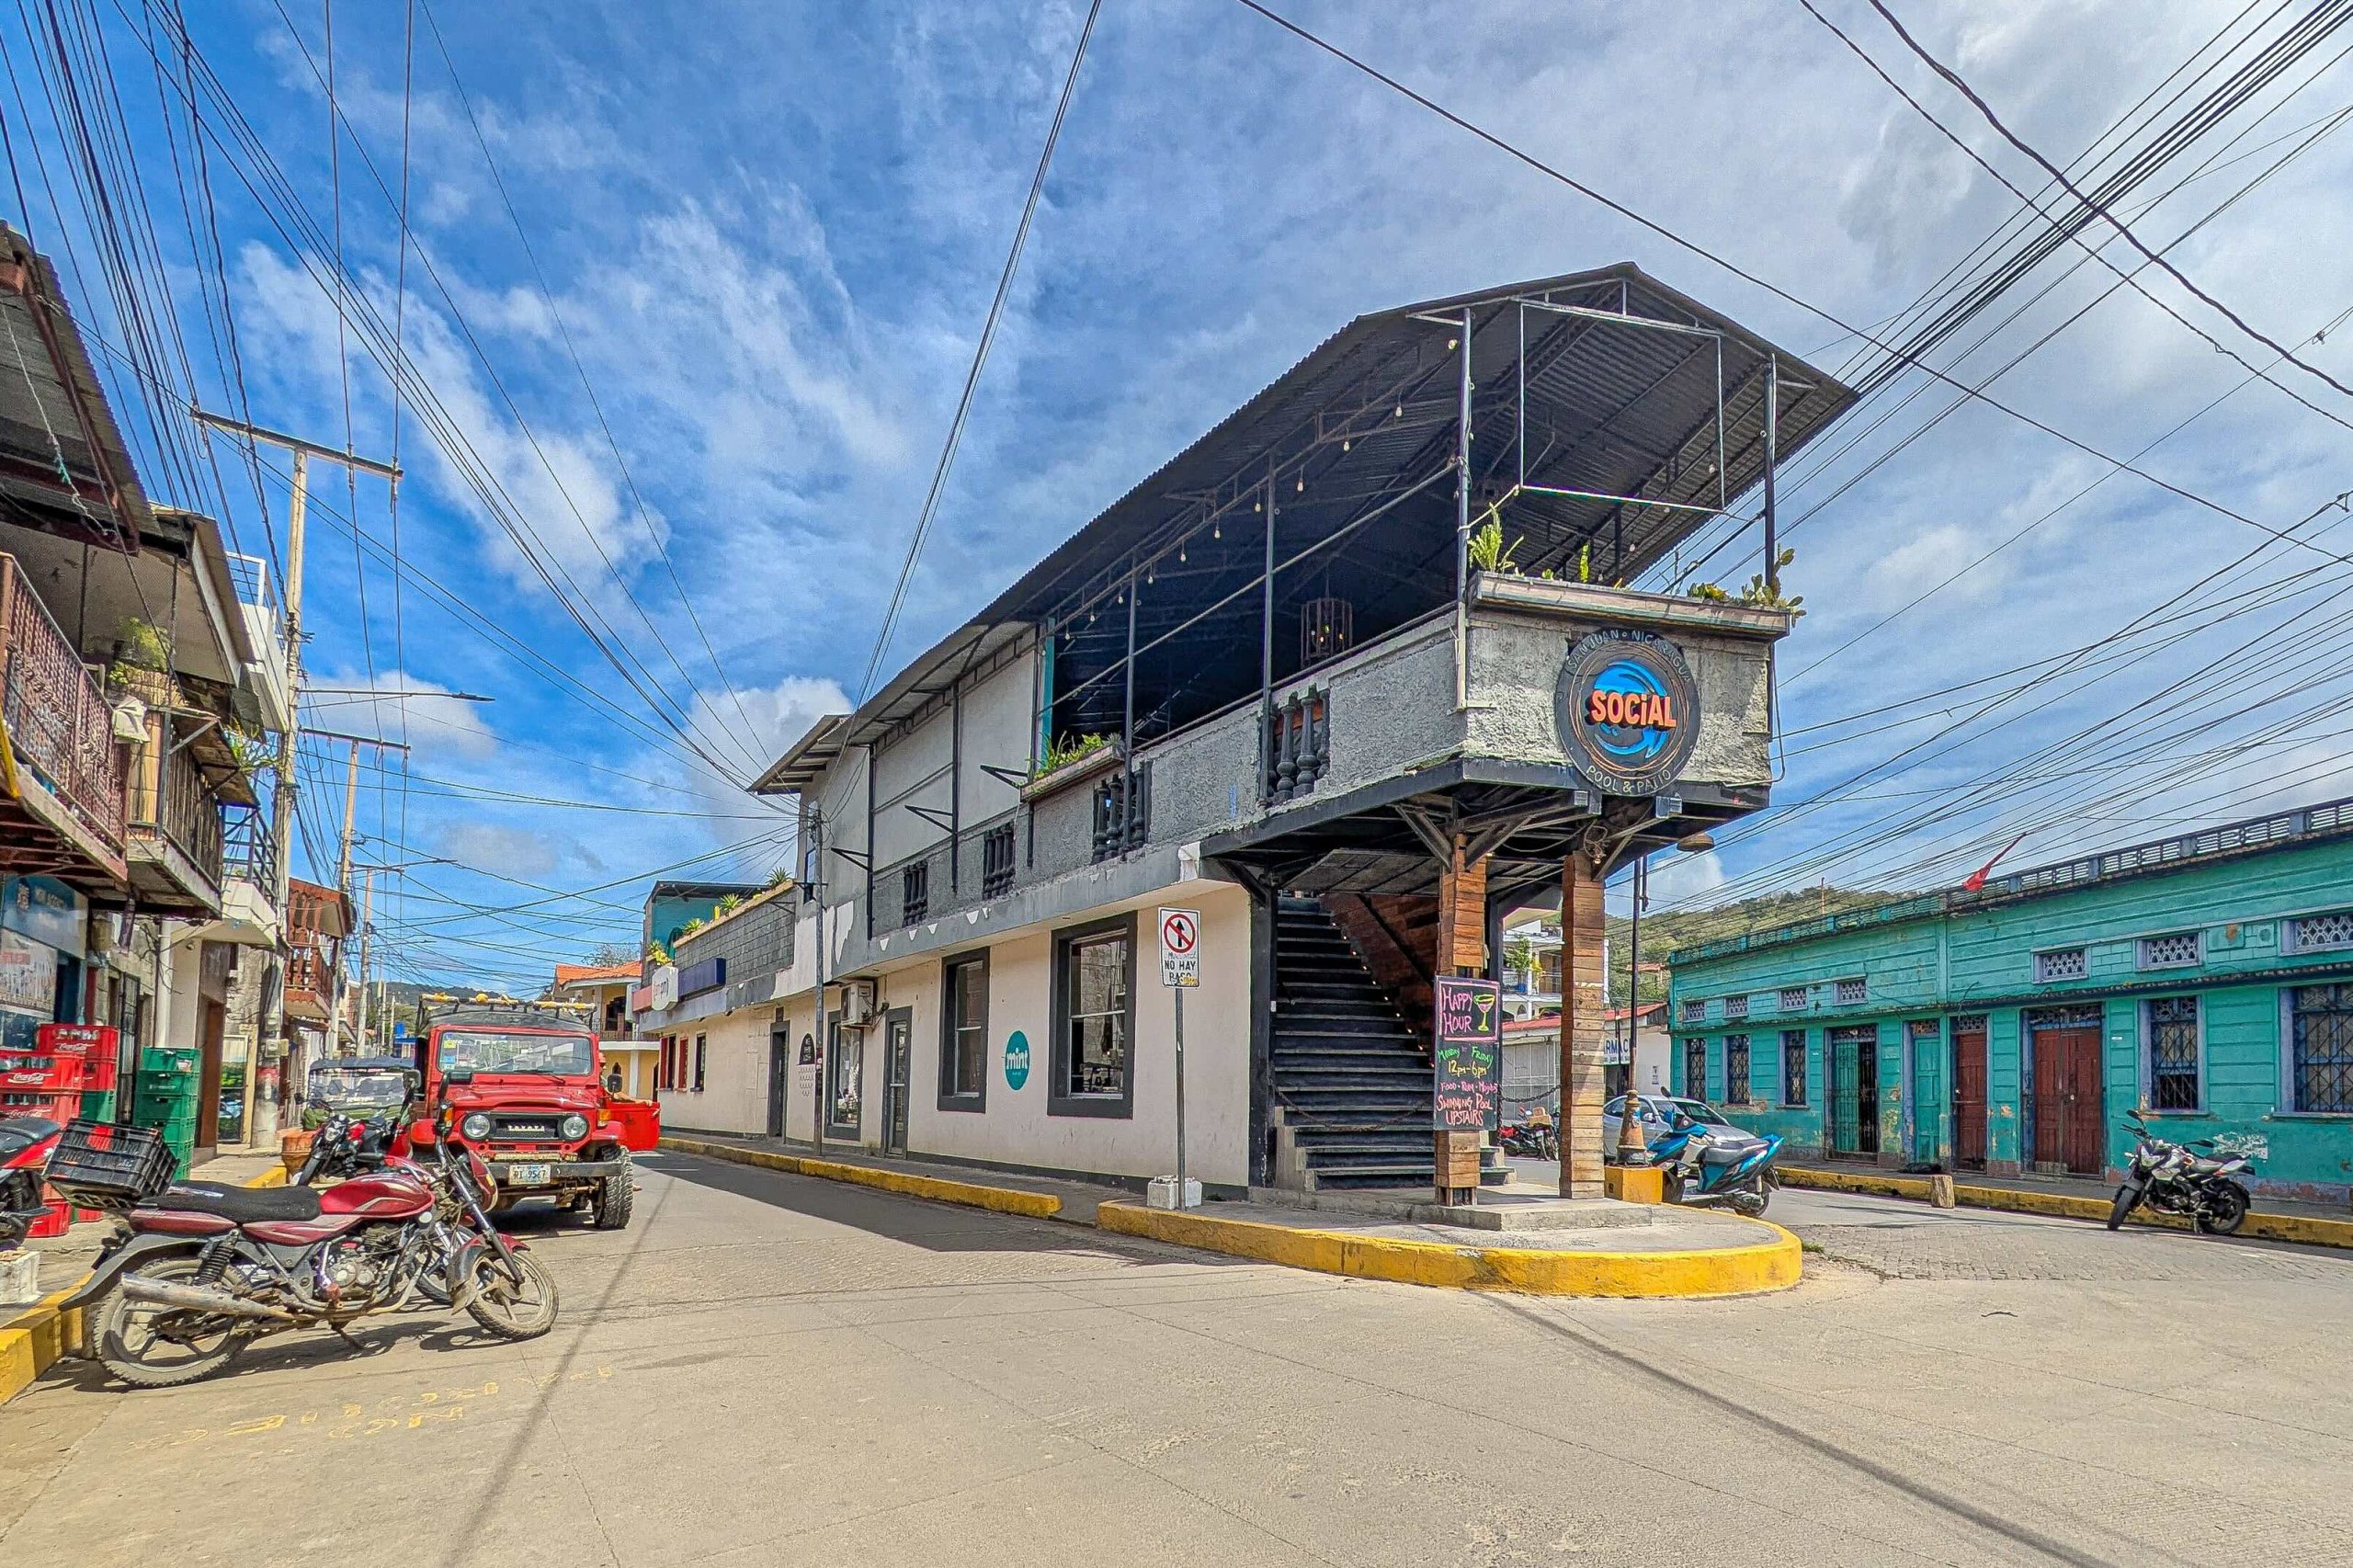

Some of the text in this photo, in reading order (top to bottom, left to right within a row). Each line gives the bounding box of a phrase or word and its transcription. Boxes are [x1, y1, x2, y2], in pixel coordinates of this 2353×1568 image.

[1567, 630, 1692, 682] SAN JUAN NICARAGUA
[1586, 765, 1672, 793] POOL & PATIO
[1165, 960, 1197, 971] NO HAY
[1442, 986, 1473, 1012] HAPPY
[1442, 1012, 1473, 1035] HOUR
[1006, 1048, 1029, 1070] mint
[1475, 1093, 1494, 1110] POOL
[1445, 1109, 1484, 1127] UPSTAIRS
